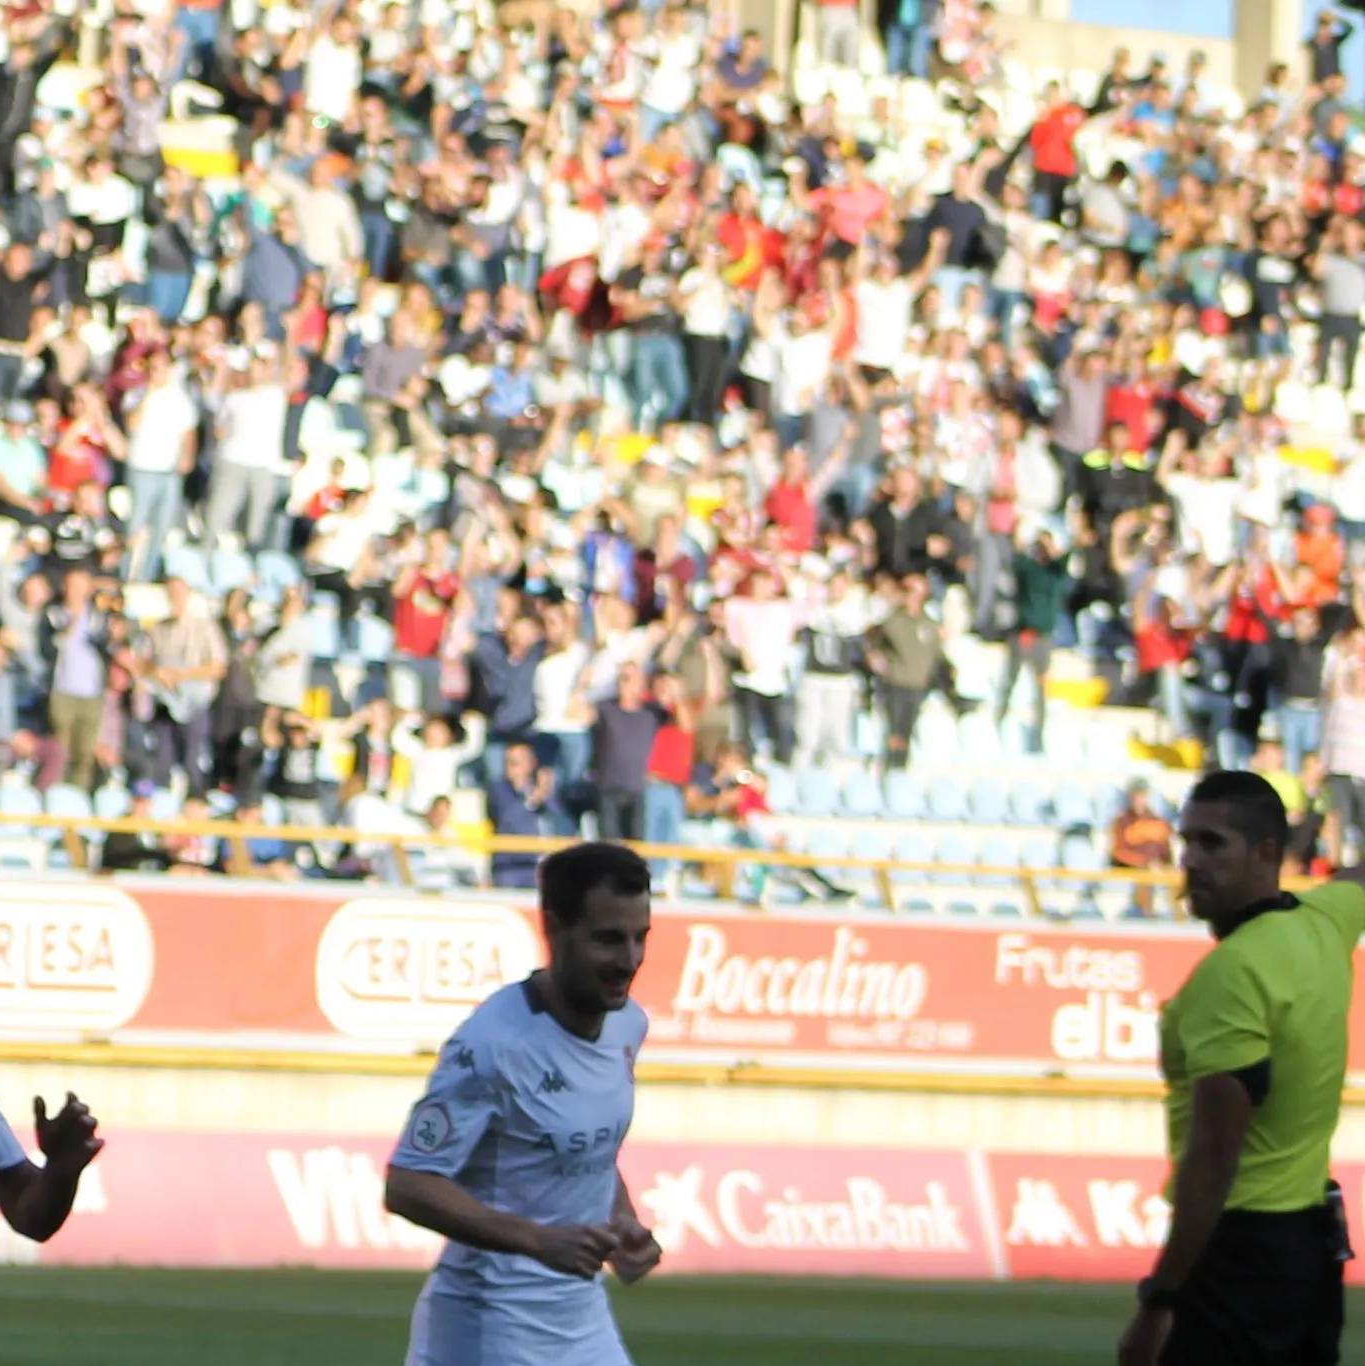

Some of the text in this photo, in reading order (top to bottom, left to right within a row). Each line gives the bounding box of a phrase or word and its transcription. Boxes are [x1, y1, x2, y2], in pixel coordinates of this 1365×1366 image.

[672, 922, 931, 1019] Boccalino
[995, 932, 1144, 992] Frutas
[717, 1169, 969, 1252] CaixaBank
